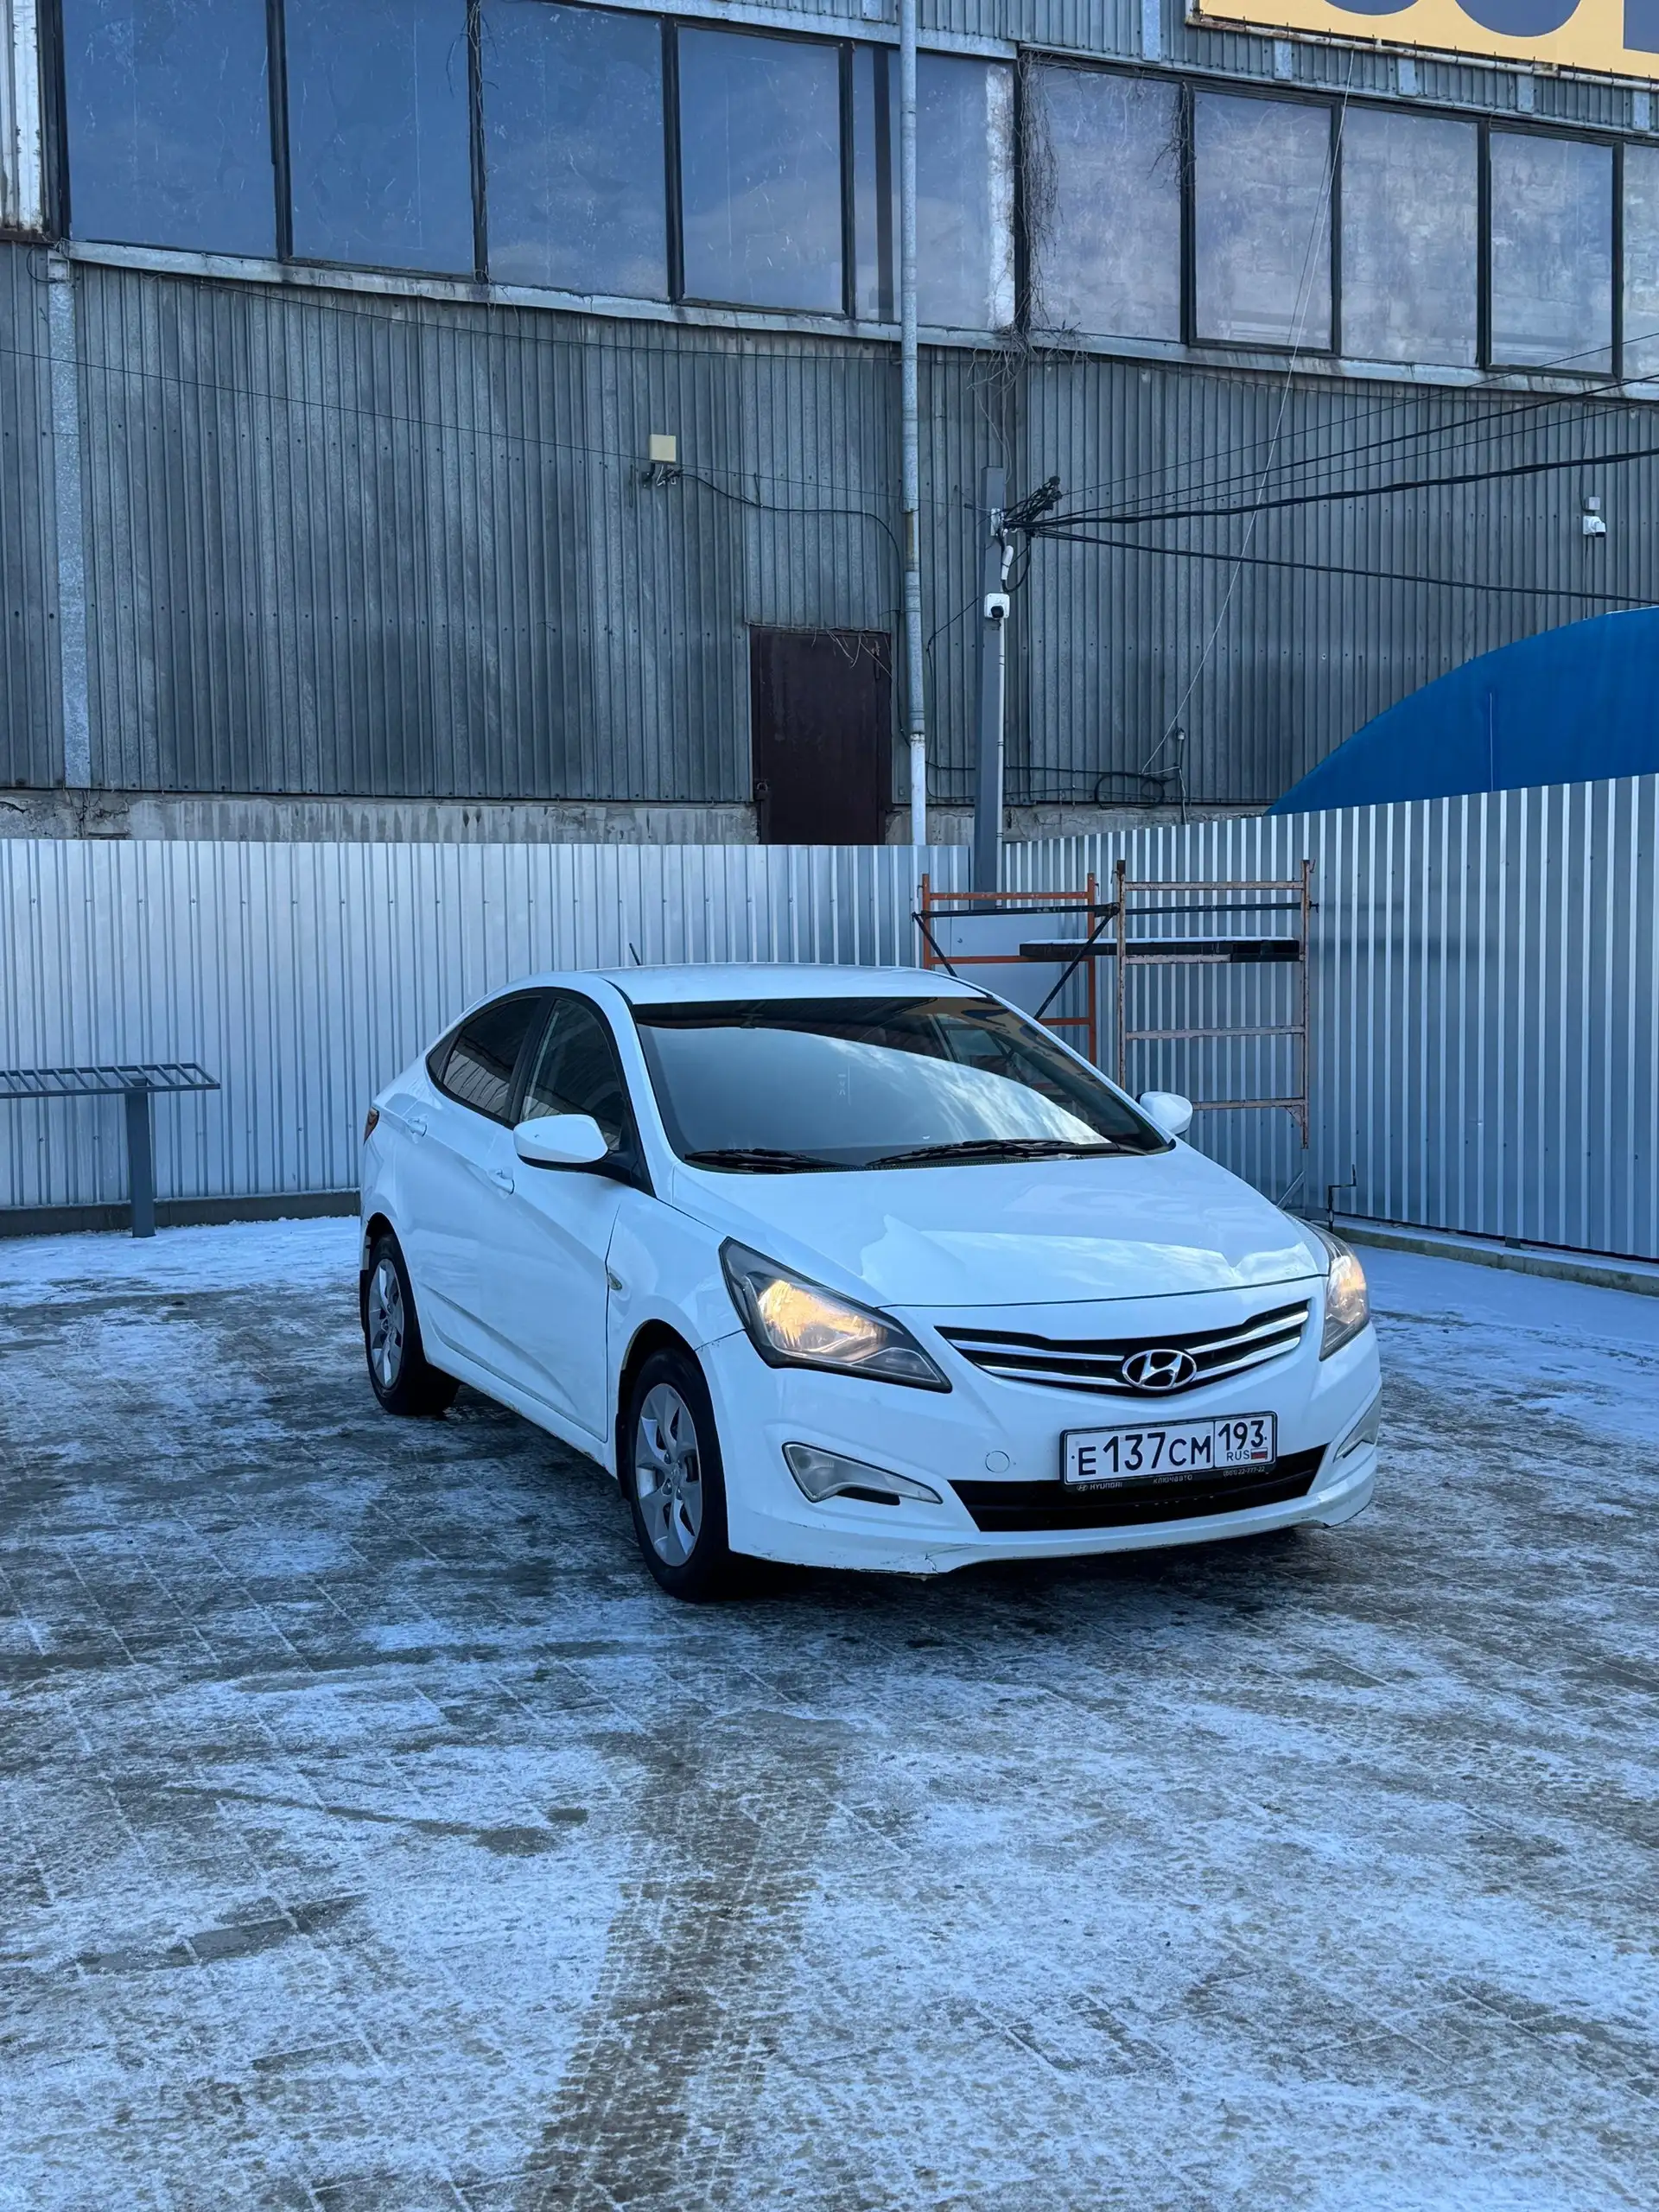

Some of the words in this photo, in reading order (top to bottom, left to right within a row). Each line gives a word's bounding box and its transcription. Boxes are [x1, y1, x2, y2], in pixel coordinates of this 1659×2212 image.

[1218, 1420, 1264, 1451] 193
[1226, 1449, 1250, 1462] RUS
[1090, 1482, 1123, 1491] HYUNDAI
